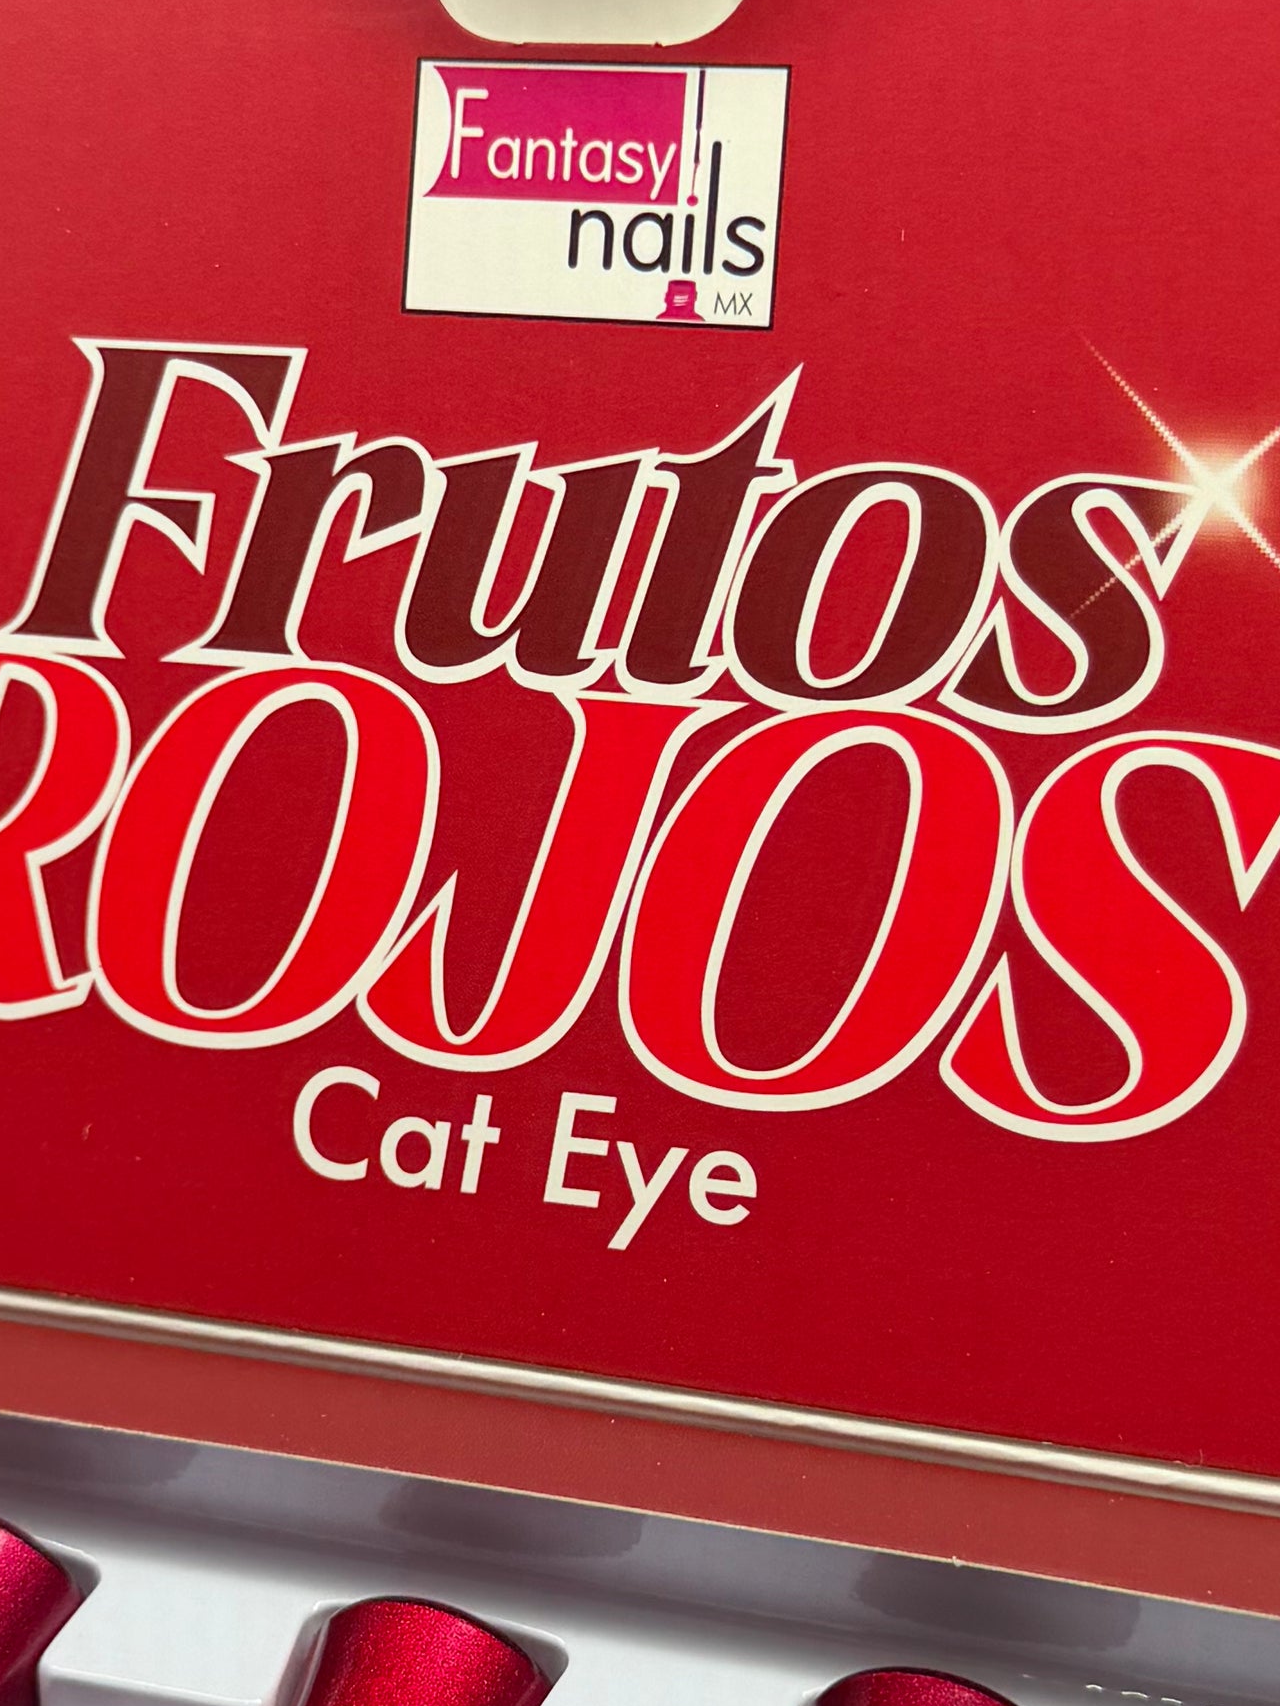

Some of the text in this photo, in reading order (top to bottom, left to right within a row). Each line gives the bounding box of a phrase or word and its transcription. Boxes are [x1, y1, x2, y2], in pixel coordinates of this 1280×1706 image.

[451, 88, 677, 200] Fantasy
[568, 141, 766, 276] nails
[713, 292, 752, 316] MX
[292, 1065, 758, 1251] Cat Eye
